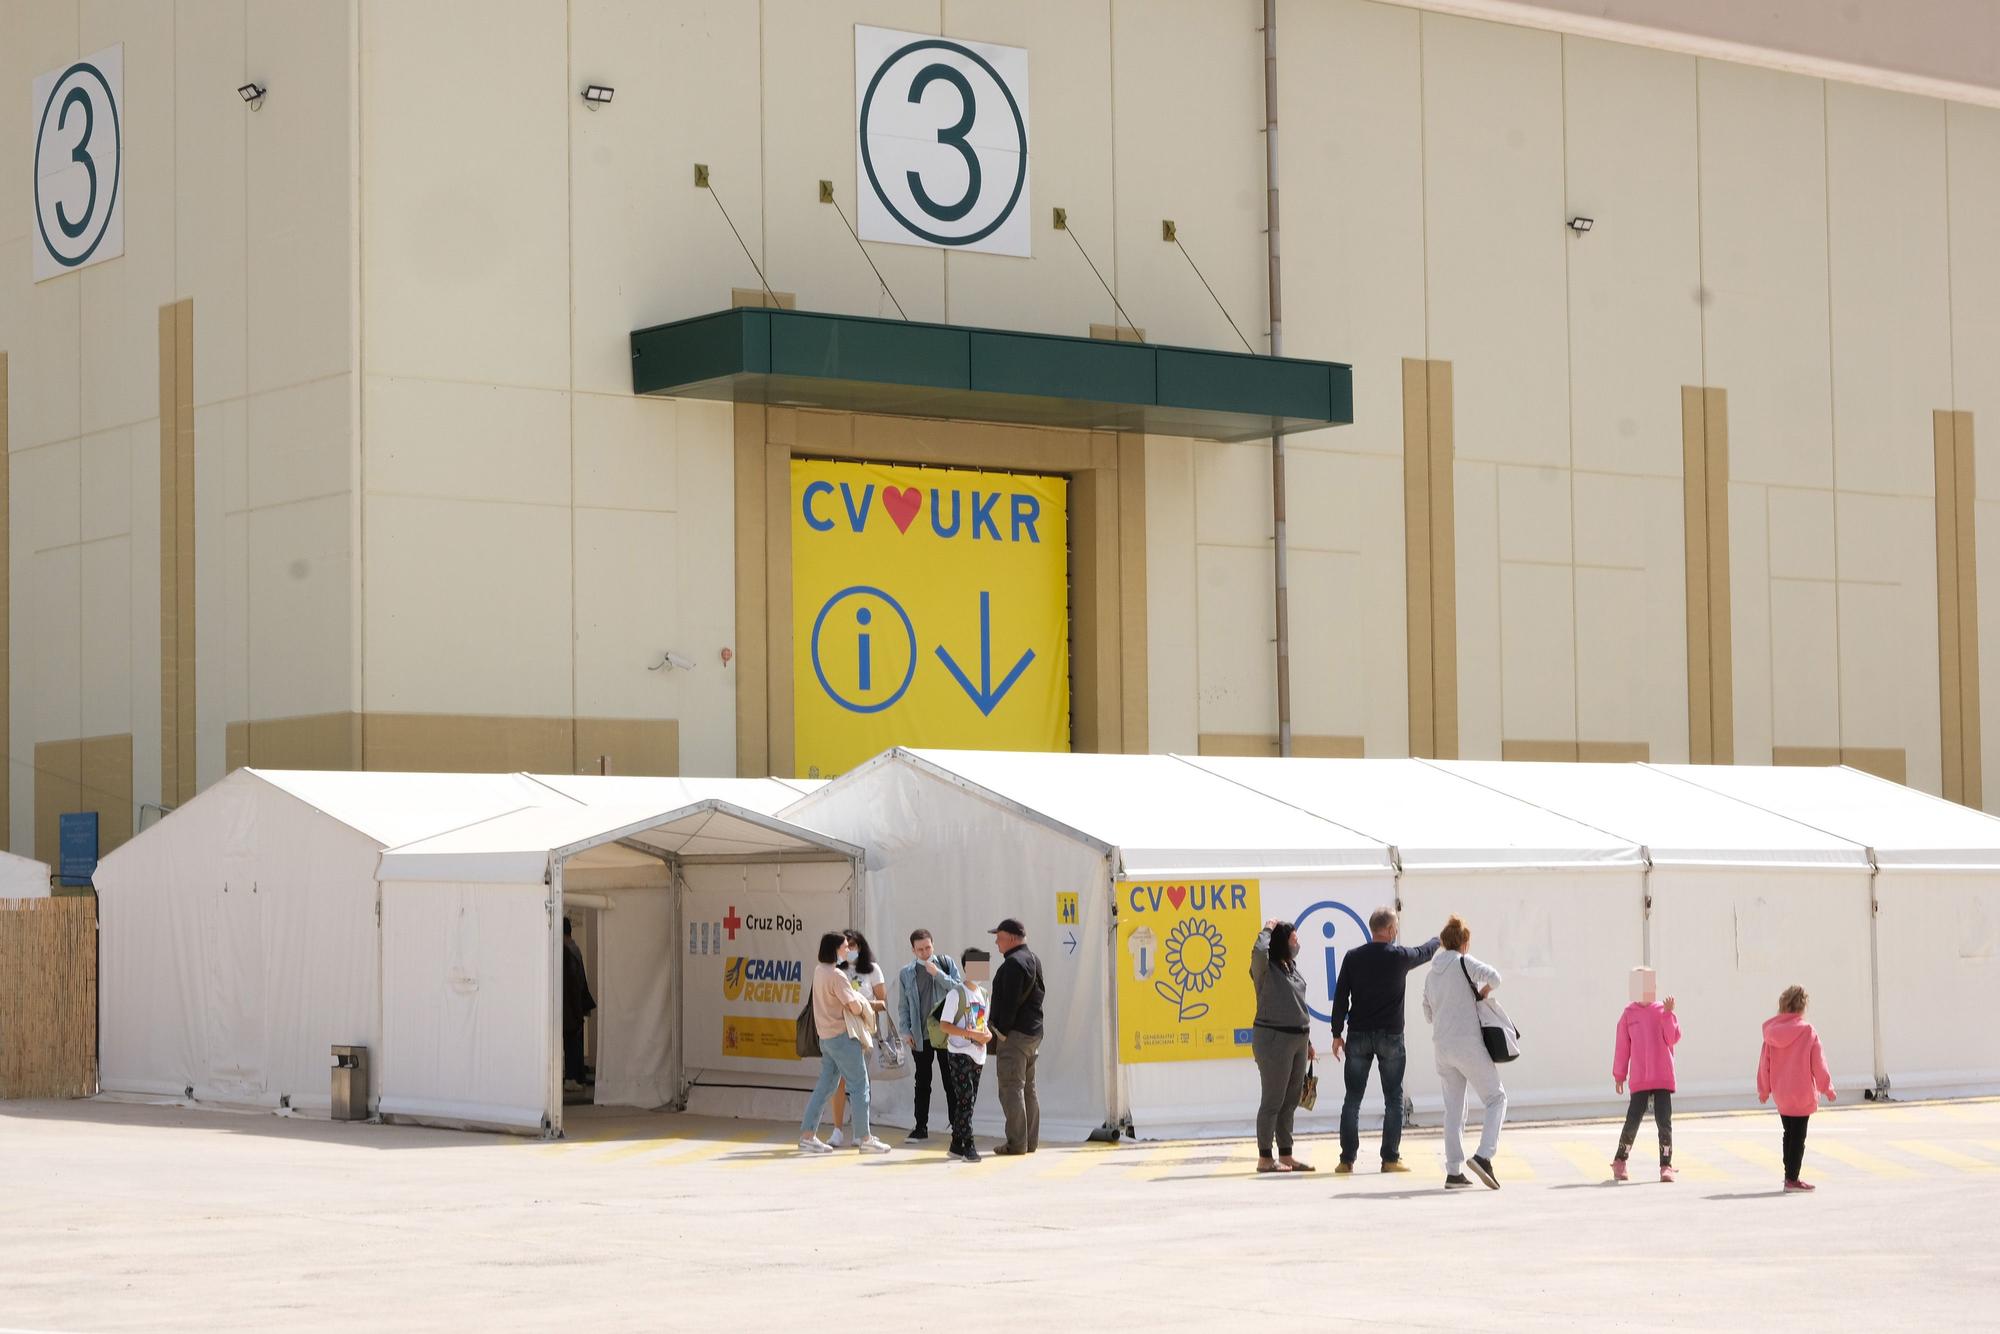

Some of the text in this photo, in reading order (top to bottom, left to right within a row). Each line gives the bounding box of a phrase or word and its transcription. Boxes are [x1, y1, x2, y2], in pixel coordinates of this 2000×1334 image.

[55, 86, 97, 238] 3
[906, 63, 982, 222] 3
[802, 480, 1041, 544] CV UKR
[745, 914, 803, 935] Cruz Roja
[1129, 884, 1247, 913] CV UKR
